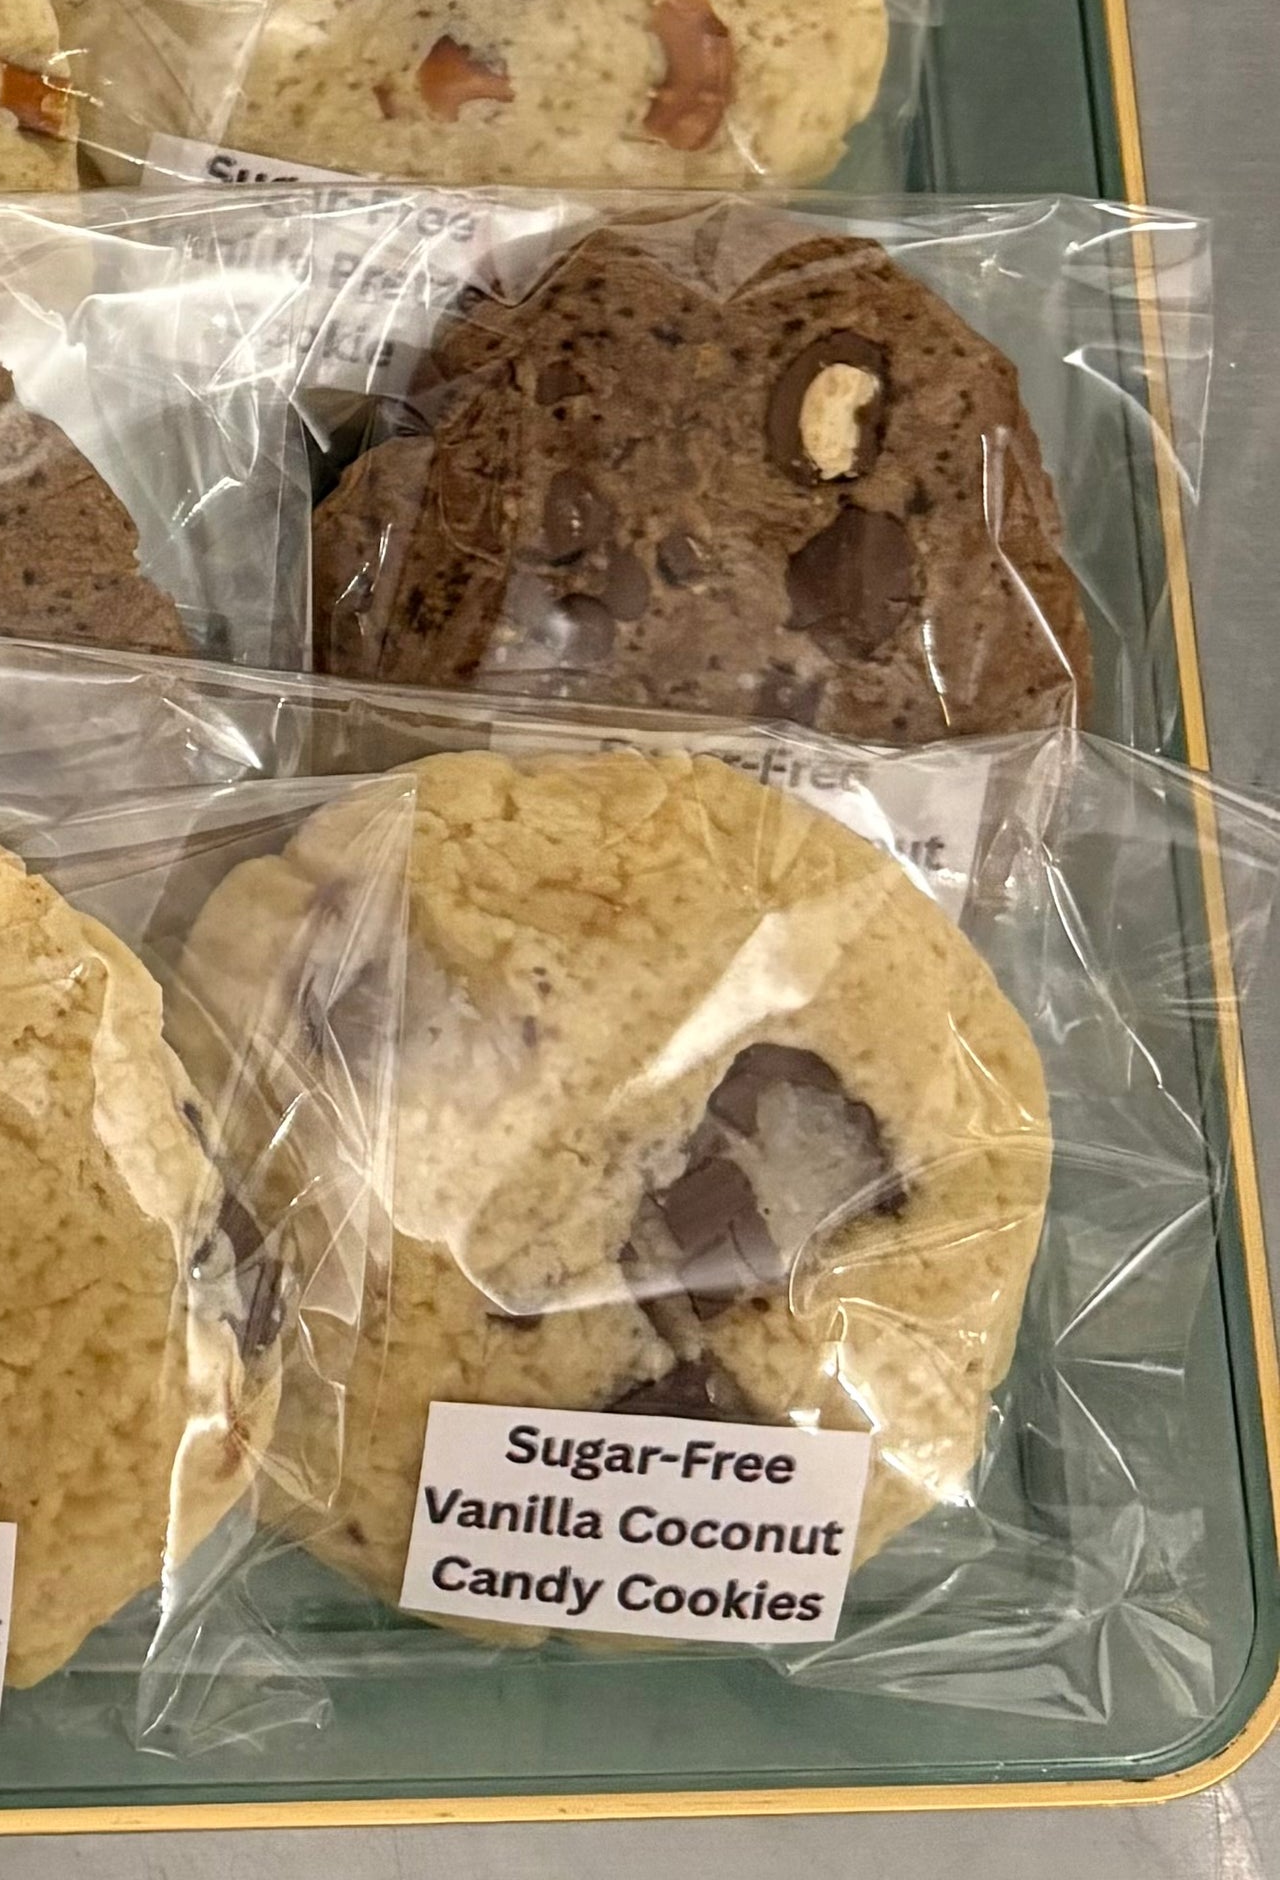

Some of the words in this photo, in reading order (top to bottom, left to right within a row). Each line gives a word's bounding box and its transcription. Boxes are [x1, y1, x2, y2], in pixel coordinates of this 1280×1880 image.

[504, 1425, 797, 1485] Sugar-Free
[424, 1486, 603, 1540] Vanilla
[618, 1505, 846, 1557] Coconut
[431, 1556, 605, 1616] Candy
[617, 1573, 825, 1622] Cookies
